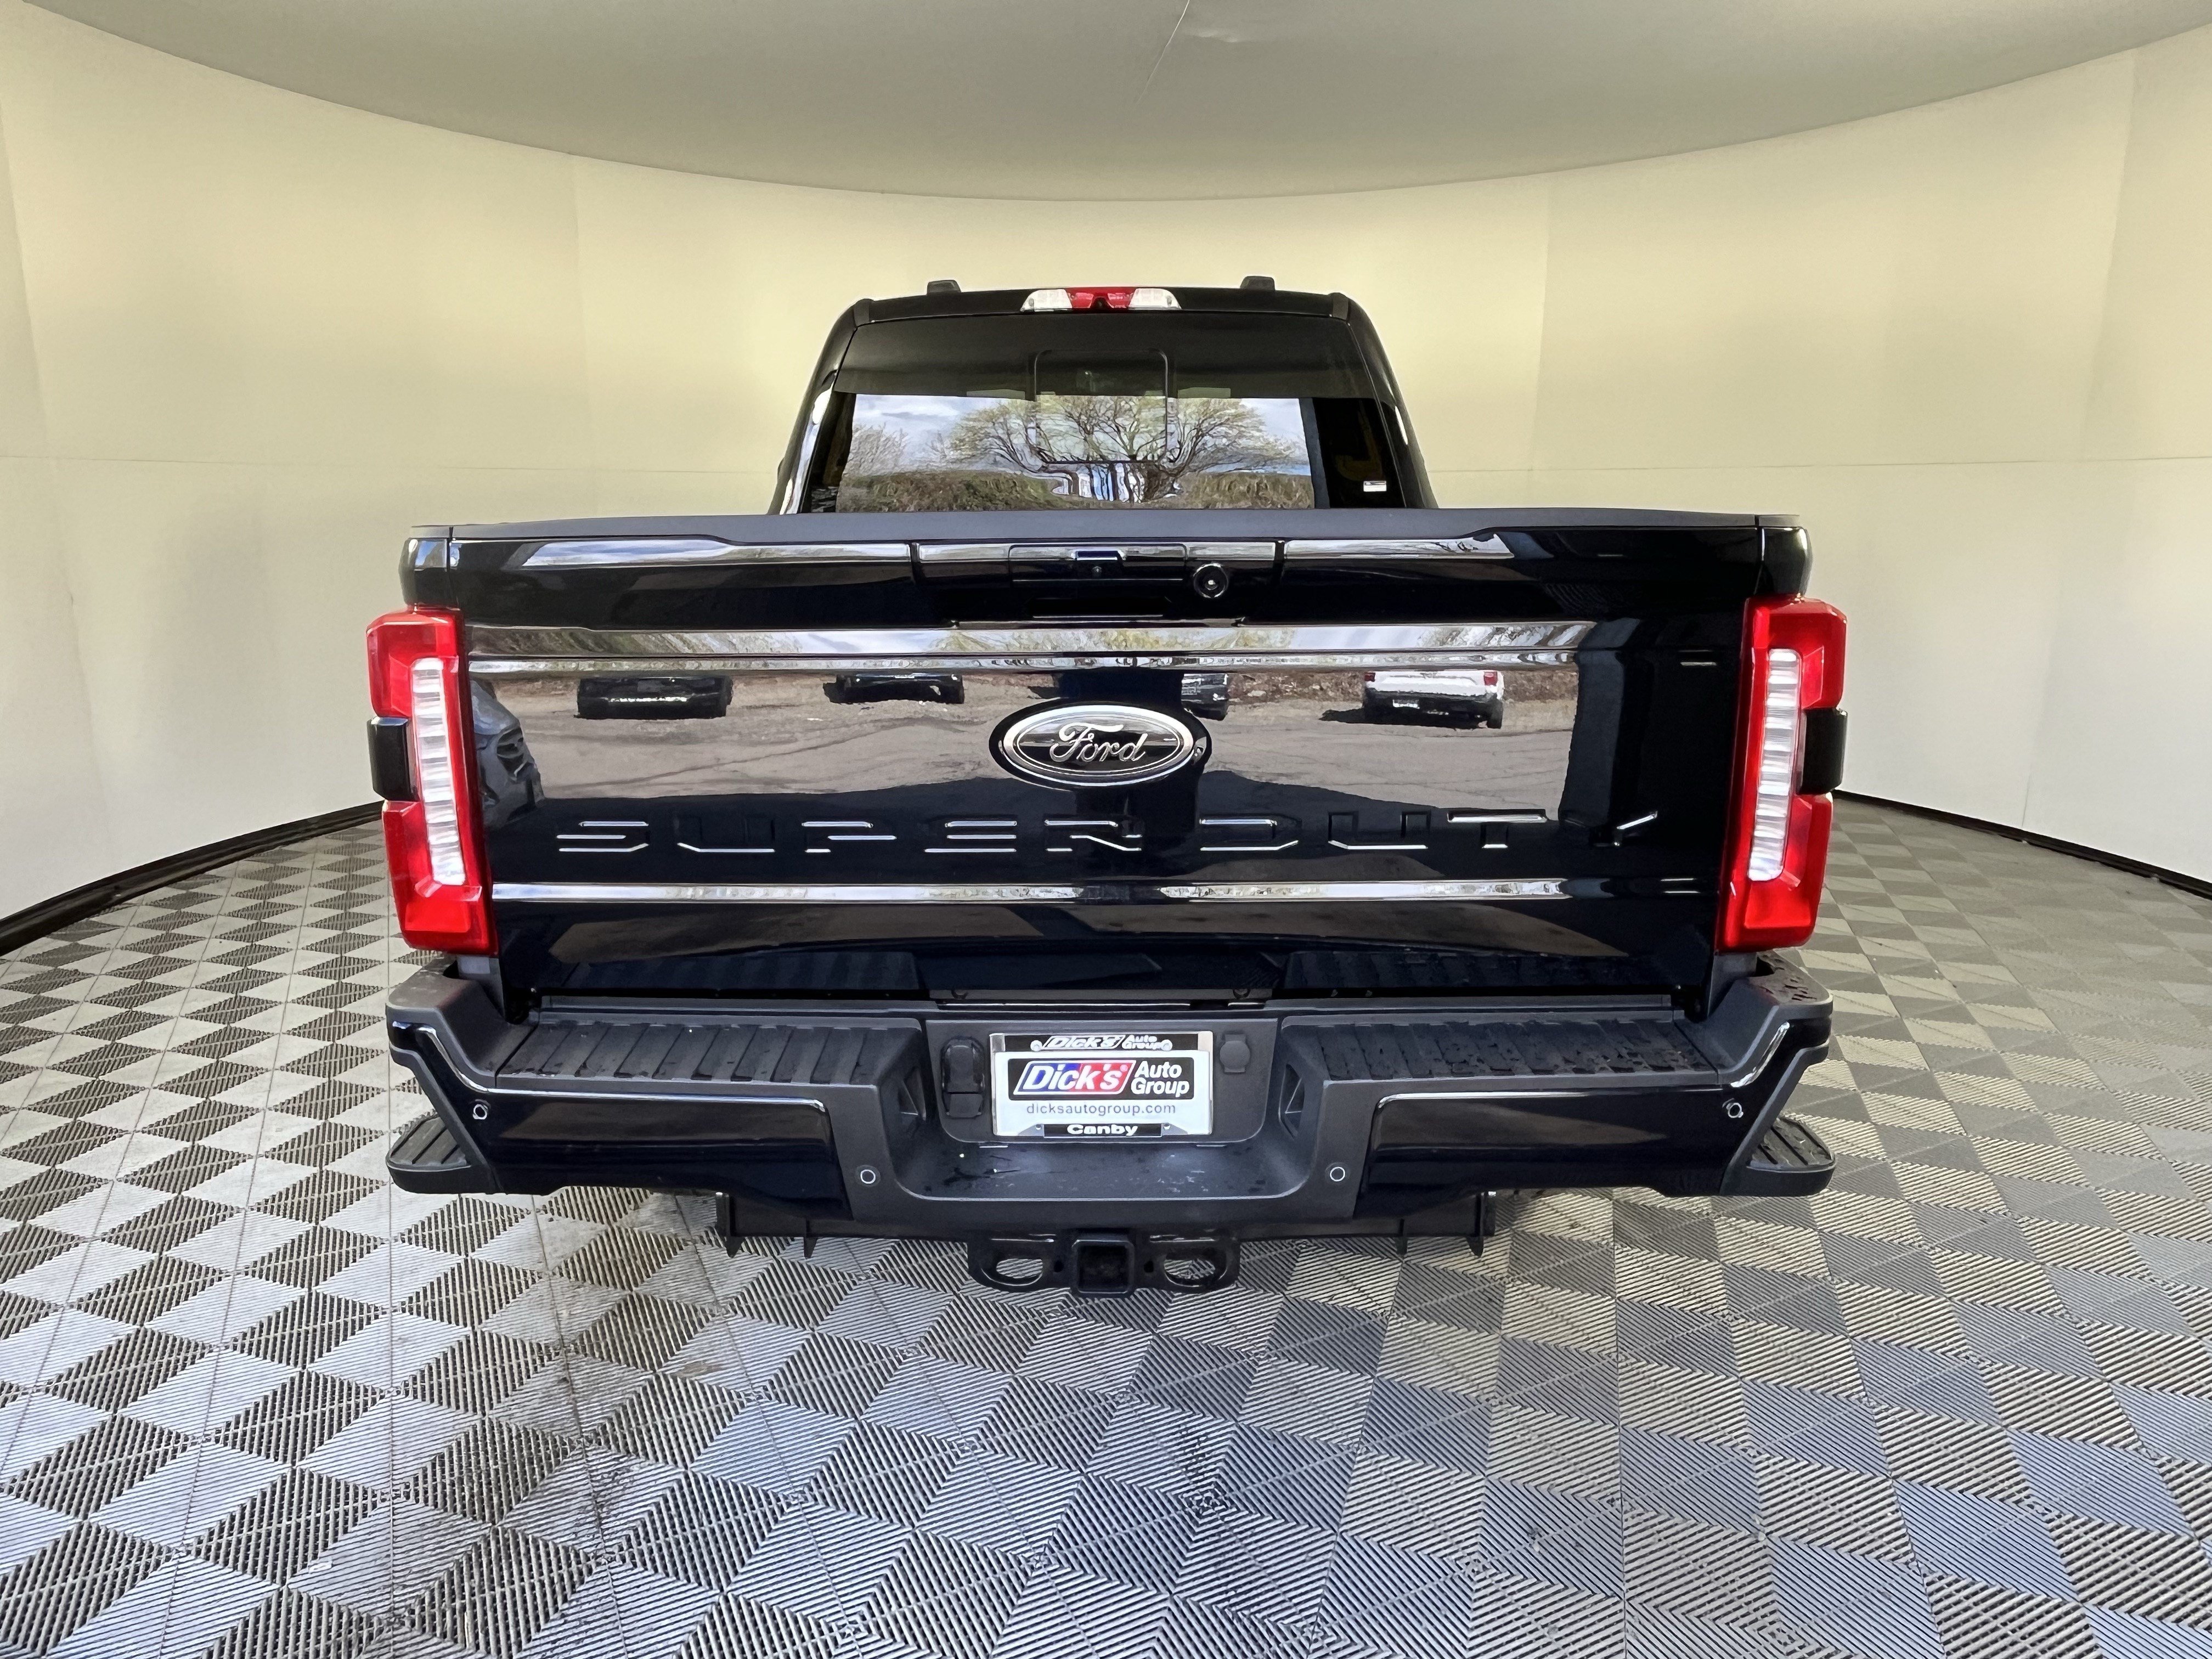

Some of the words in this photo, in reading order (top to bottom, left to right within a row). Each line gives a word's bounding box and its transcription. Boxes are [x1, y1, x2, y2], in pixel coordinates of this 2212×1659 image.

[1049, 722, 1148, 763] Ford
[556, 819, 1144, 854] SUPER
[1199, 809, 1658, 852] DUTY
[1022, 1063, 1121, 1091] Dick's
[1134, 1060, 1182, 1079] Auto
[1130, 1077, 1190, 1098] Group
[1026, 1103, 1176, 1116] dicksautogroup.com
[1066, 1124, 1138, 1136] Canby
